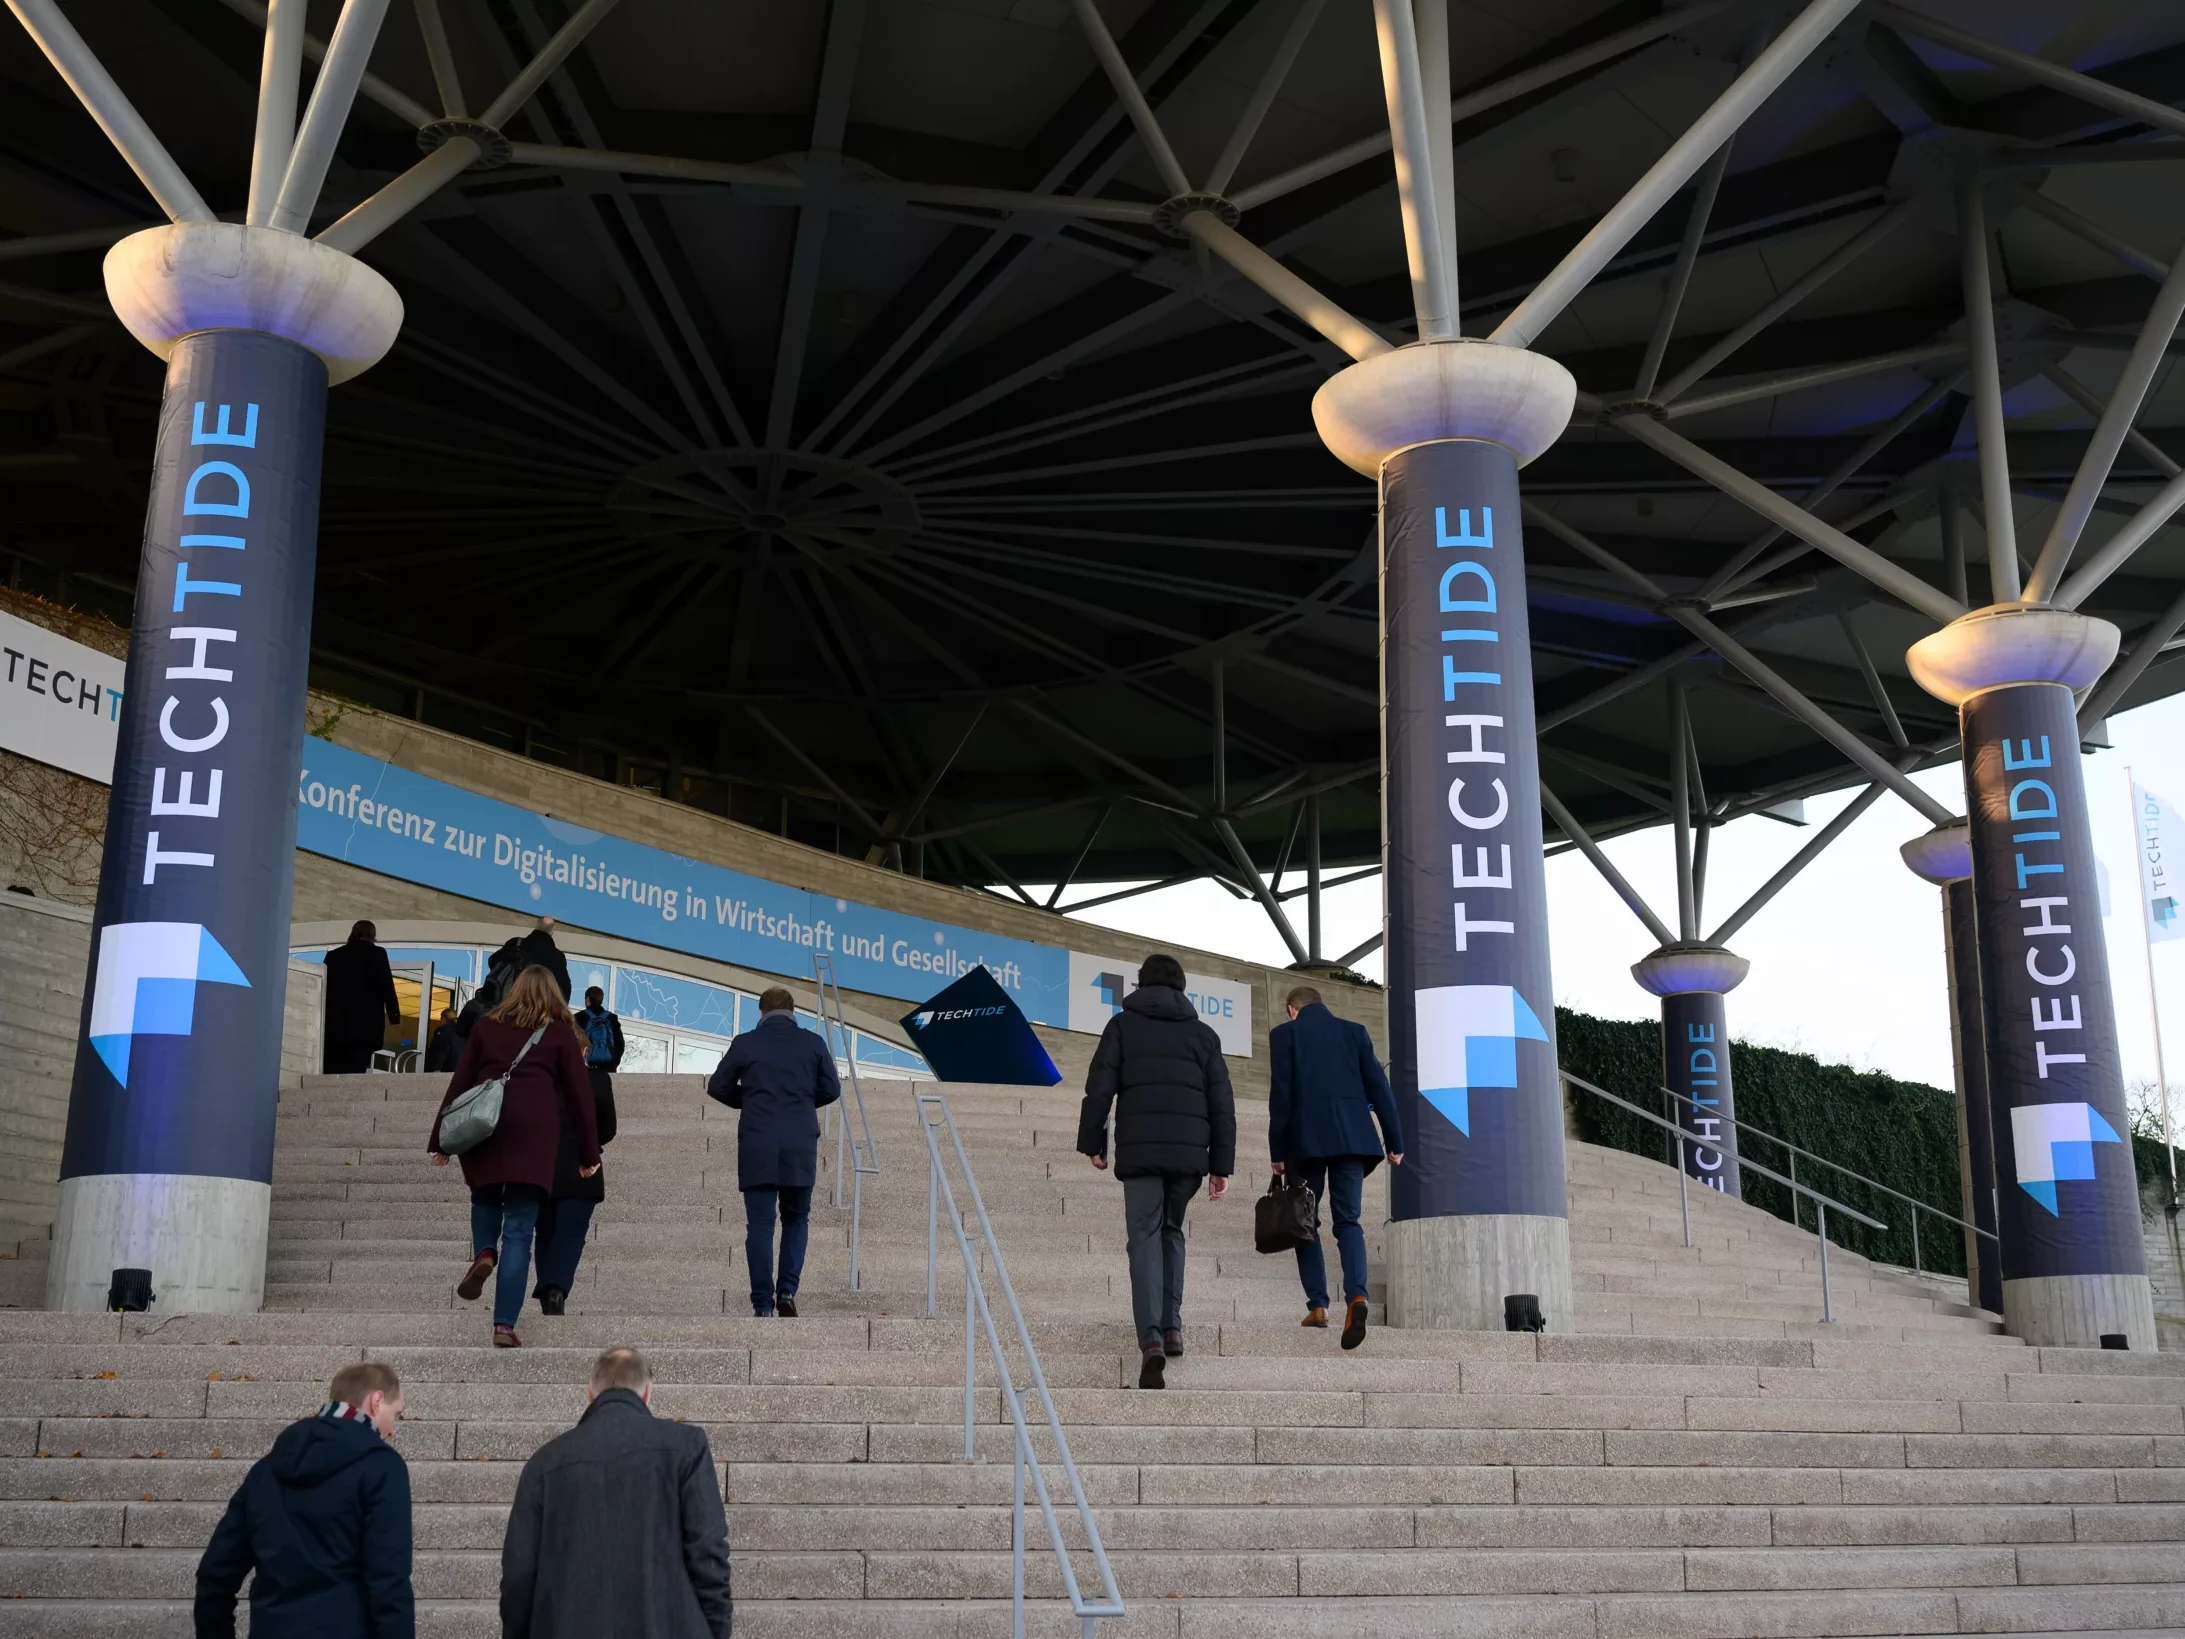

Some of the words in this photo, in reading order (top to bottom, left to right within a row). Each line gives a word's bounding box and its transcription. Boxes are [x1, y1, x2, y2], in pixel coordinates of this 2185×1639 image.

[143, 401, 259, 885] TECHTIDE
[1435, 506, 1514, 952] TECHTIDE
[444, 824, 487, 860] zur
[494, 833, 679, 922] Digitalisierung
[685, 886, 707, 920] in
[716, 895, 835, 952] Wirtschaft
[842, 933, 885, 962] und
[937, 1005, 1006, 1021] TECHTIDE
[2002, 734, 2089, 1079] TECHTIDE
